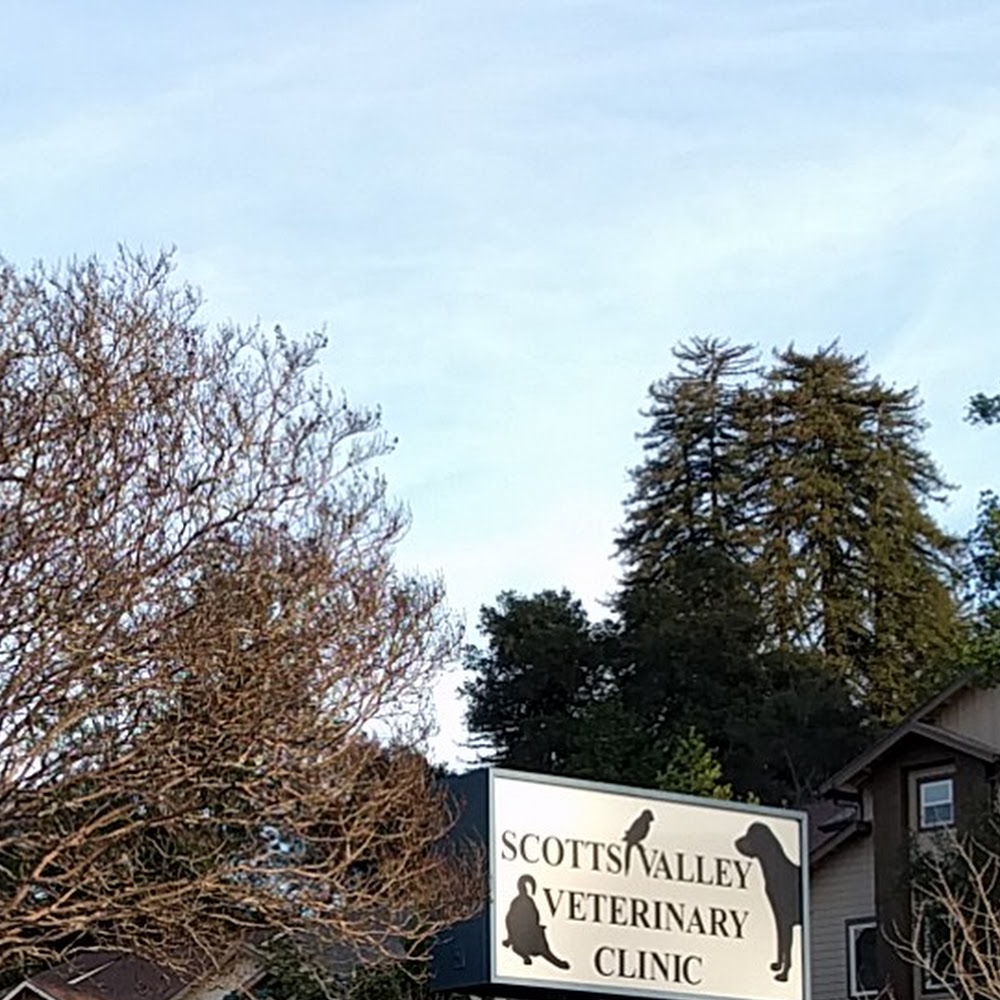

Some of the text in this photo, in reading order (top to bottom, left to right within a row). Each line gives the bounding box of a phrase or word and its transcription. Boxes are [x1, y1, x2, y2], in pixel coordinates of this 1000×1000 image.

[501, 829, 752, 889] SCOTTS VALLEY
[543, 887, 749, 939] VETERINARY
[594, 946, 703, 986] CLINIC
